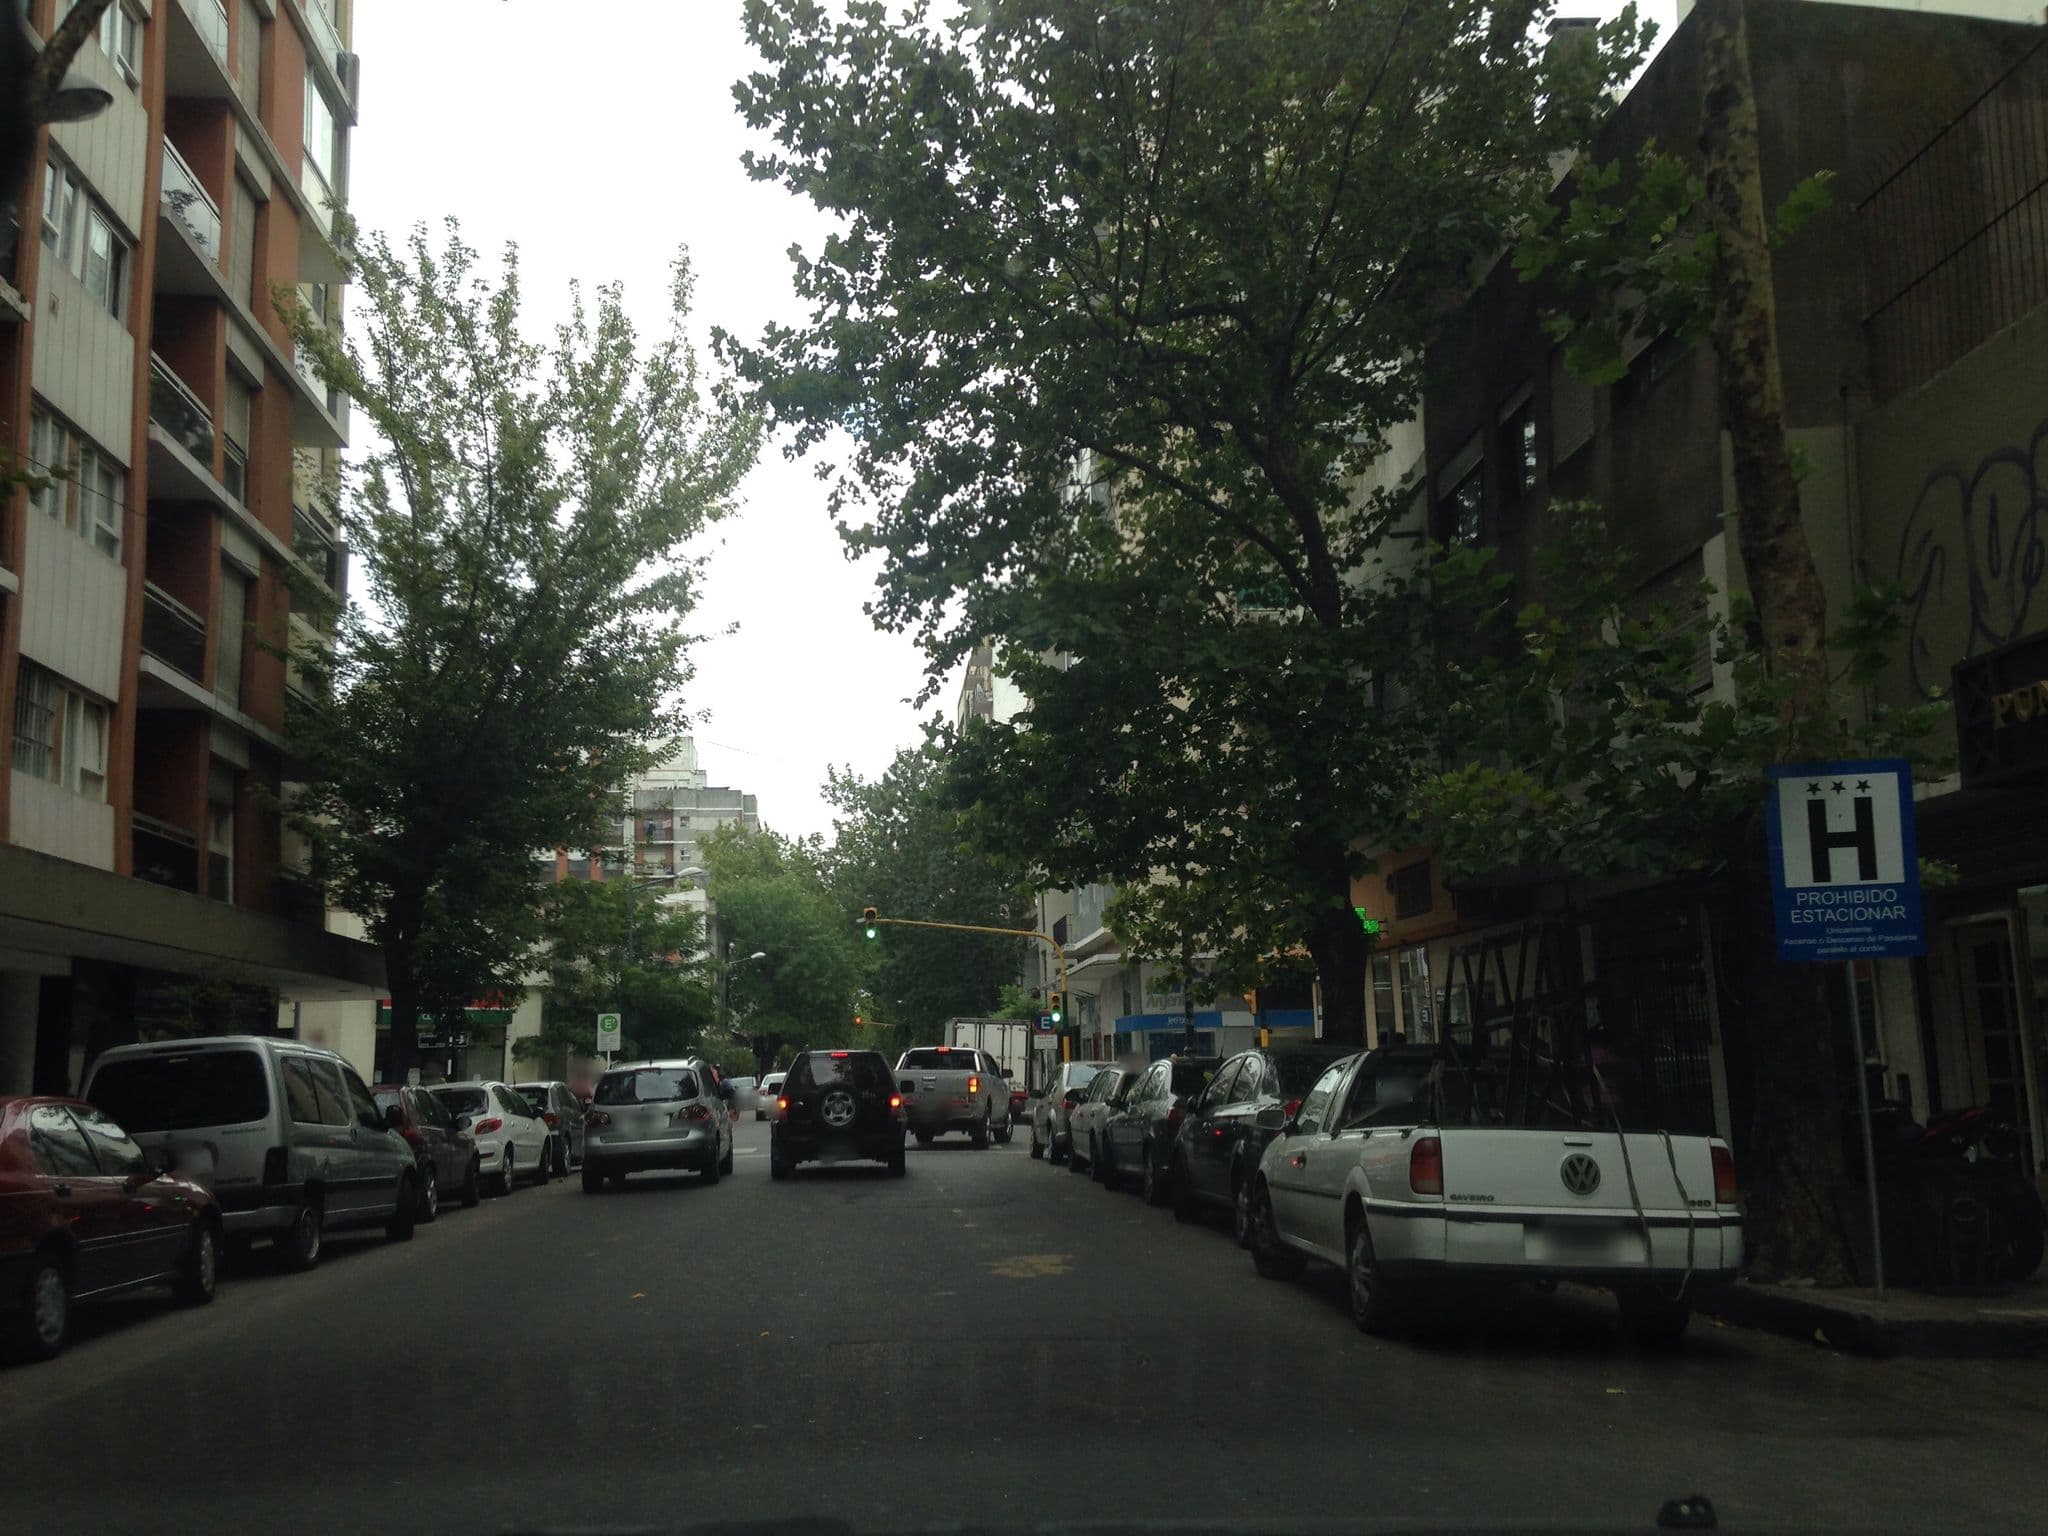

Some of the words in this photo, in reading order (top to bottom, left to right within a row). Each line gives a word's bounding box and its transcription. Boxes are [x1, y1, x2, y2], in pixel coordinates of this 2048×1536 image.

[1807, 797, 1878, 883] H
[1796, 889, 1898, 906] PROHIBIDO
[1790, 906, 1907, 923] ESTACIONAR
[1041, 1016, 1051, 1029] E
